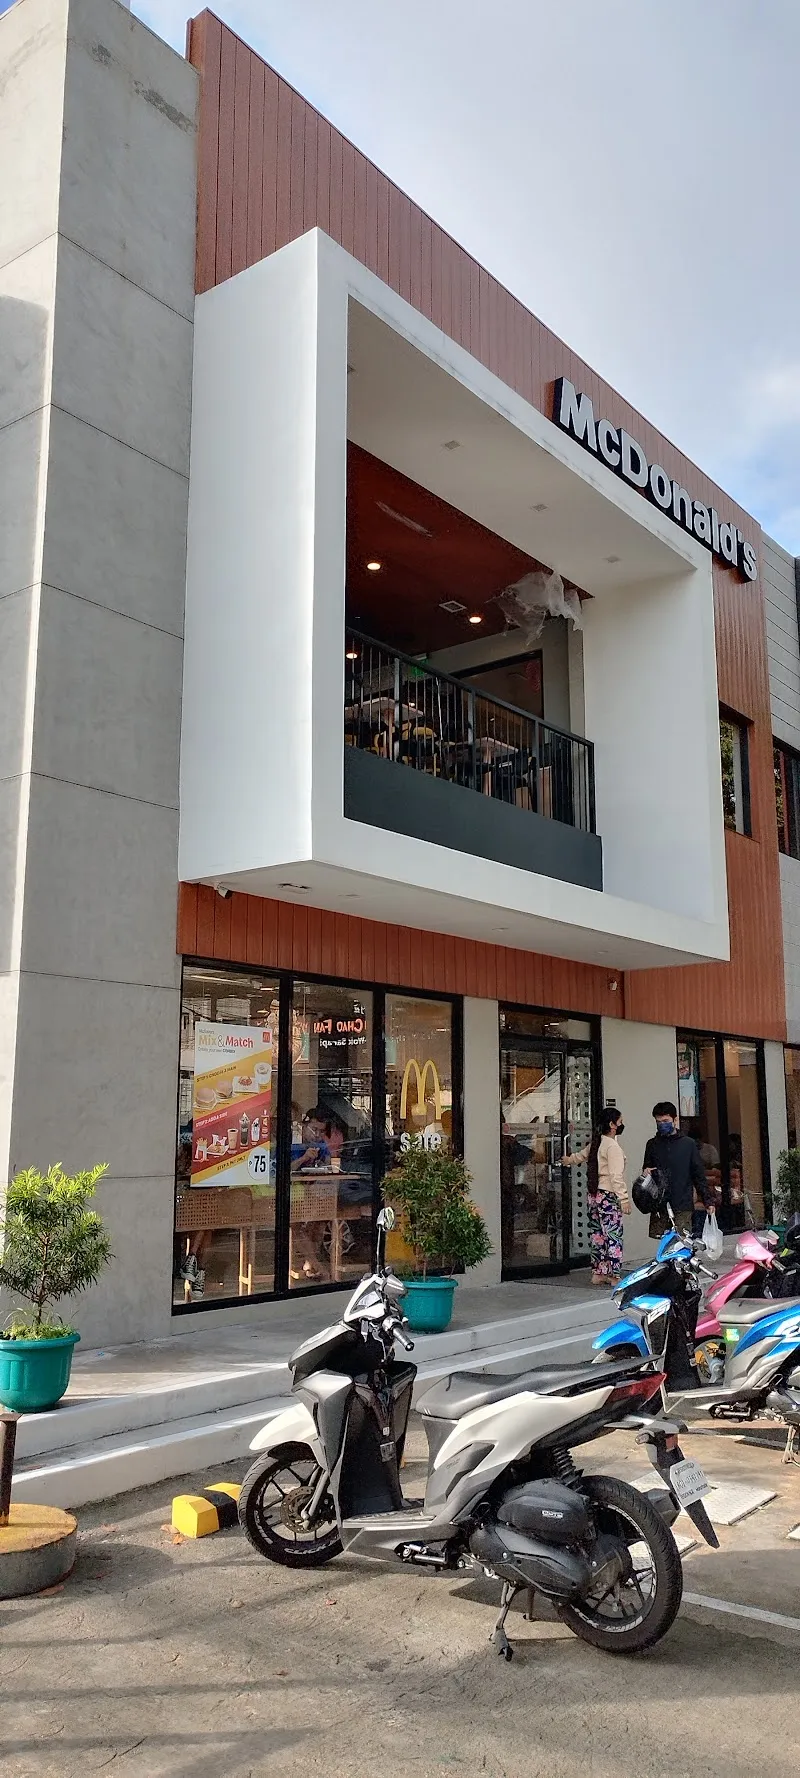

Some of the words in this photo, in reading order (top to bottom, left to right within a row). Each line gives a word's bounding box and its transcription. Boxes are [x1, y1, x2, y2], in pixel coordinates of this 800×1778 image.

[555, 377, 758, 582] McDonald's
[199, 1034, 216, 1046] Mix
[225, 1036, 253, 1048] Match
[254, 1155, 266, 1173] 75
